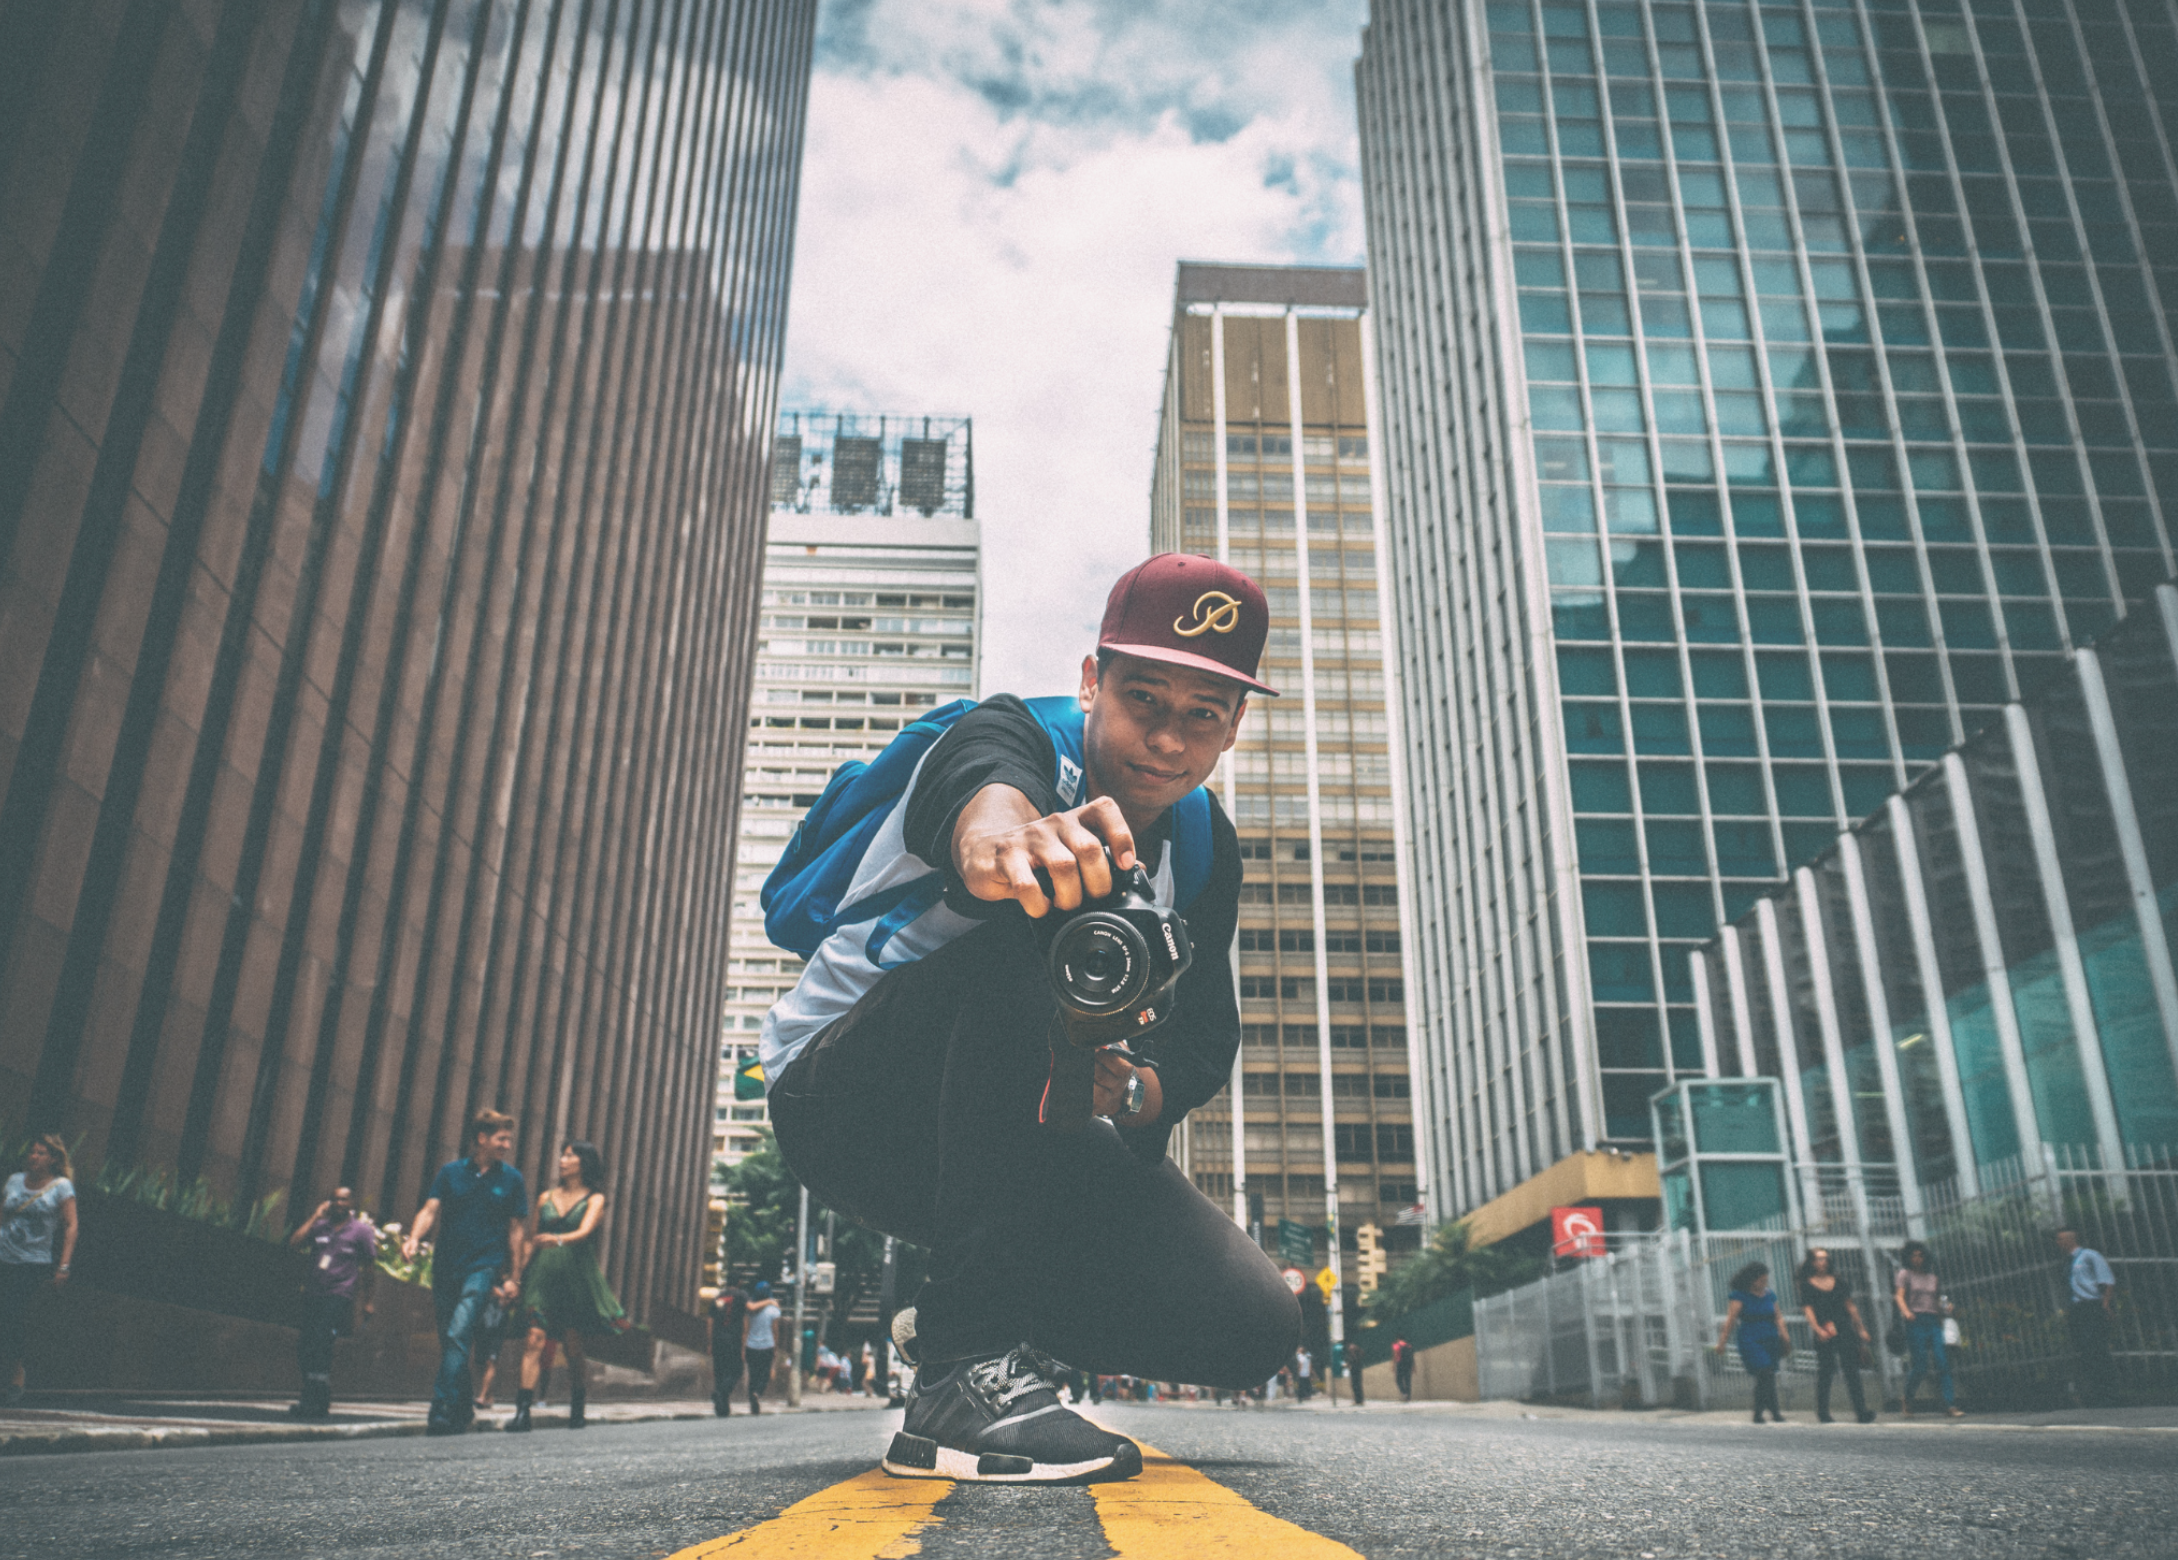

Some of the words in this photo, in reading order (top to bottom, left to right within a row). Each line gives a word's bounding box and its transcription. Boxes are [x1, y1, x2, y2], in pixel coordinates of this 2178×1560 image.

[1093, 930, 1111, 938] CANON
[1112, 935, 1123, 945] LENS
[1161, 922, 1179, 961] Canon
[1146, 1007, 1157, 1022] EOS
